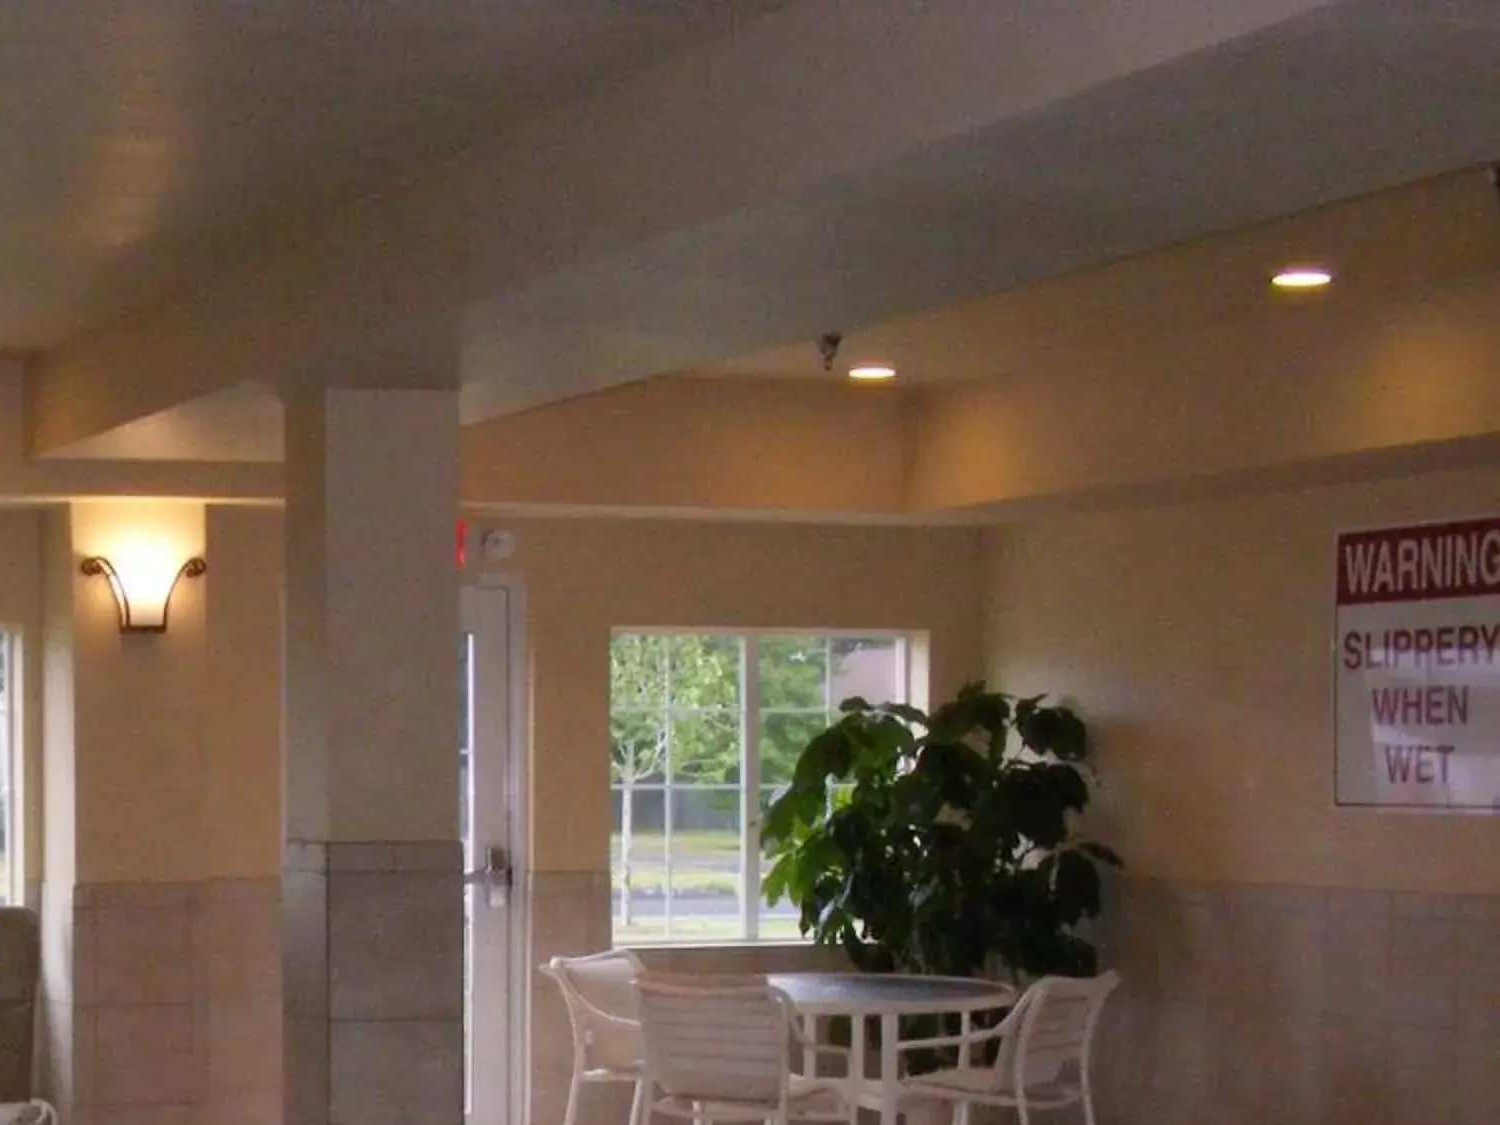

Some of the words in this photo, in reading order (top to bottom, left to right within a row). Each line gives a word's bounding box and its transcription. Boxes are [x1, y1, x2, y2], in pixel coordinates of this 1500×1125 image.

[1343, 623, 1500, 670] SLIPPERY
[1372, 685, 1469, 726] WHEN
[1384, 745, 1455, 784] WET
